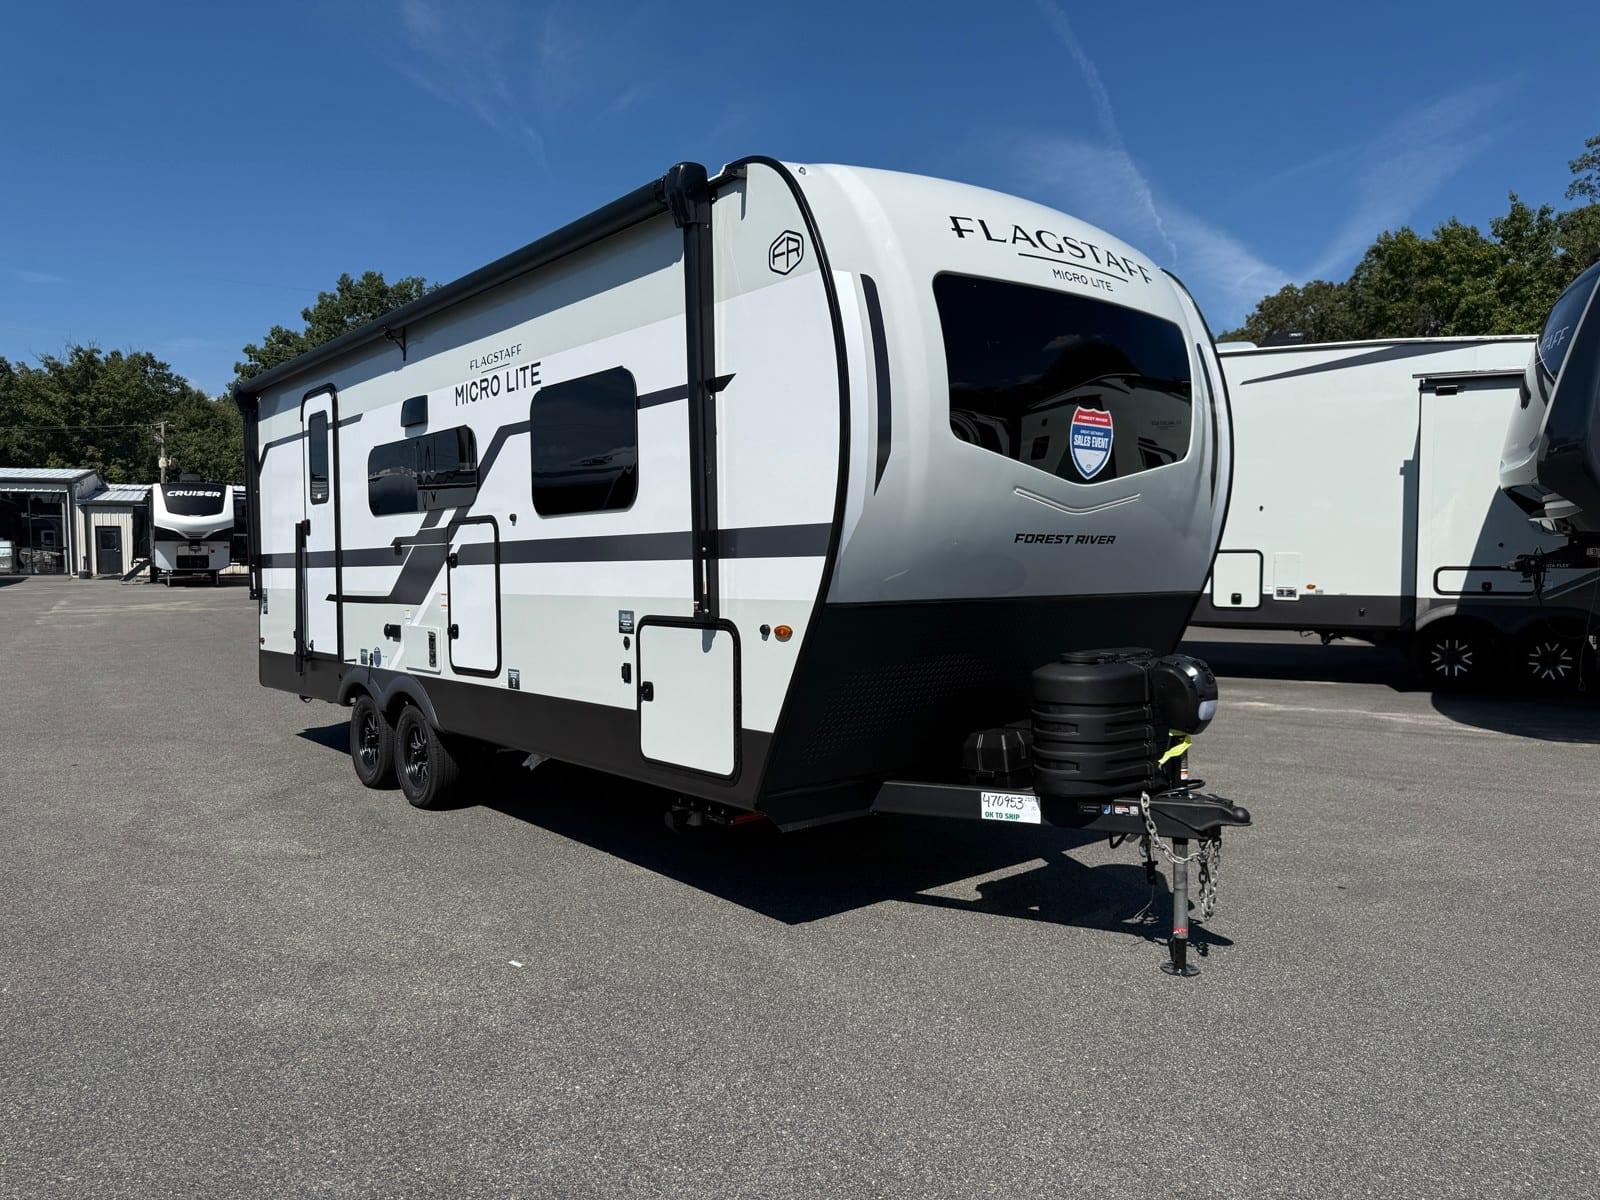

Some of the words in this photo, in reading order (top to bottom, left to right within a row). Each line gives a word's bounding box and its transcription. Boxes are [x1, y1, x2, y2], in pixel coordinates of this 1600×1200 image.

[949, 215, 1153, 285] FLAGSTAFF
[1052, 268, 1088, 286] MICRO
[1090, 277, 1114, 293] LITE
[469, 343, 523, 371] FLAGSTAFF
[455, 374, 501, 407] MICRO
[506, 361, 542, 393] LITE
[1073, 434, 1091, 446] SALES
[1091, 436, 1109, 448] EVENT
[166, 490, 222, 498] CRUISER
[1014, 533, 1074, 545] FOREST
[1074, 535, 1117, 545] RIVER
[982, 793, 1025, 810] 470953
